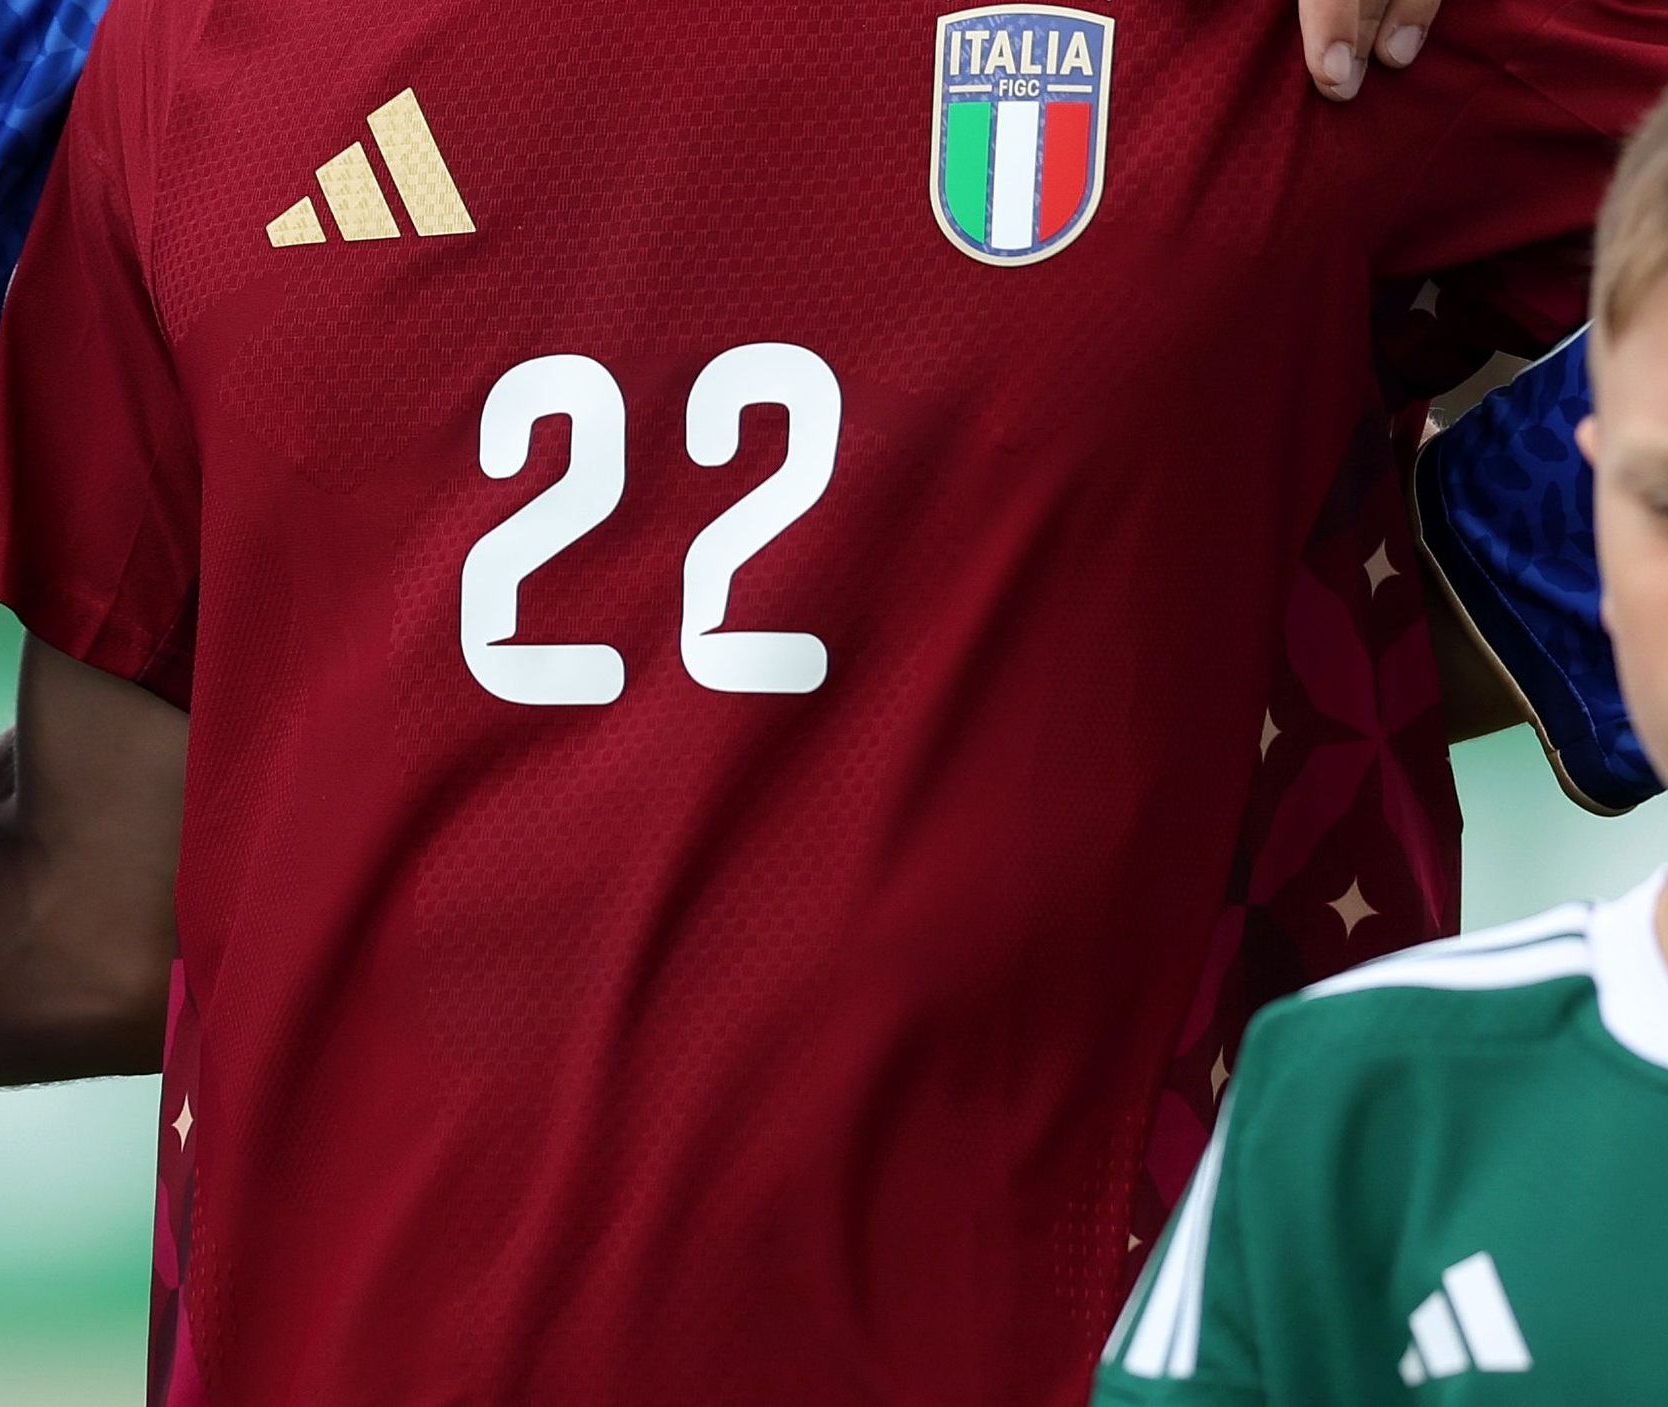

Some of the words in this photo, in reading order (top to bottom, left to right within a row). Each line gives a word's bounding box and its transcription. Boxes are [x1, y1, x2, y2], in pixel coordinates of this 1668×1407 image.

[949, 30, 1094, 76] ITALIA
[998, 79, 1040, 97] FIGC
[460, 342, 842, 706] 22
